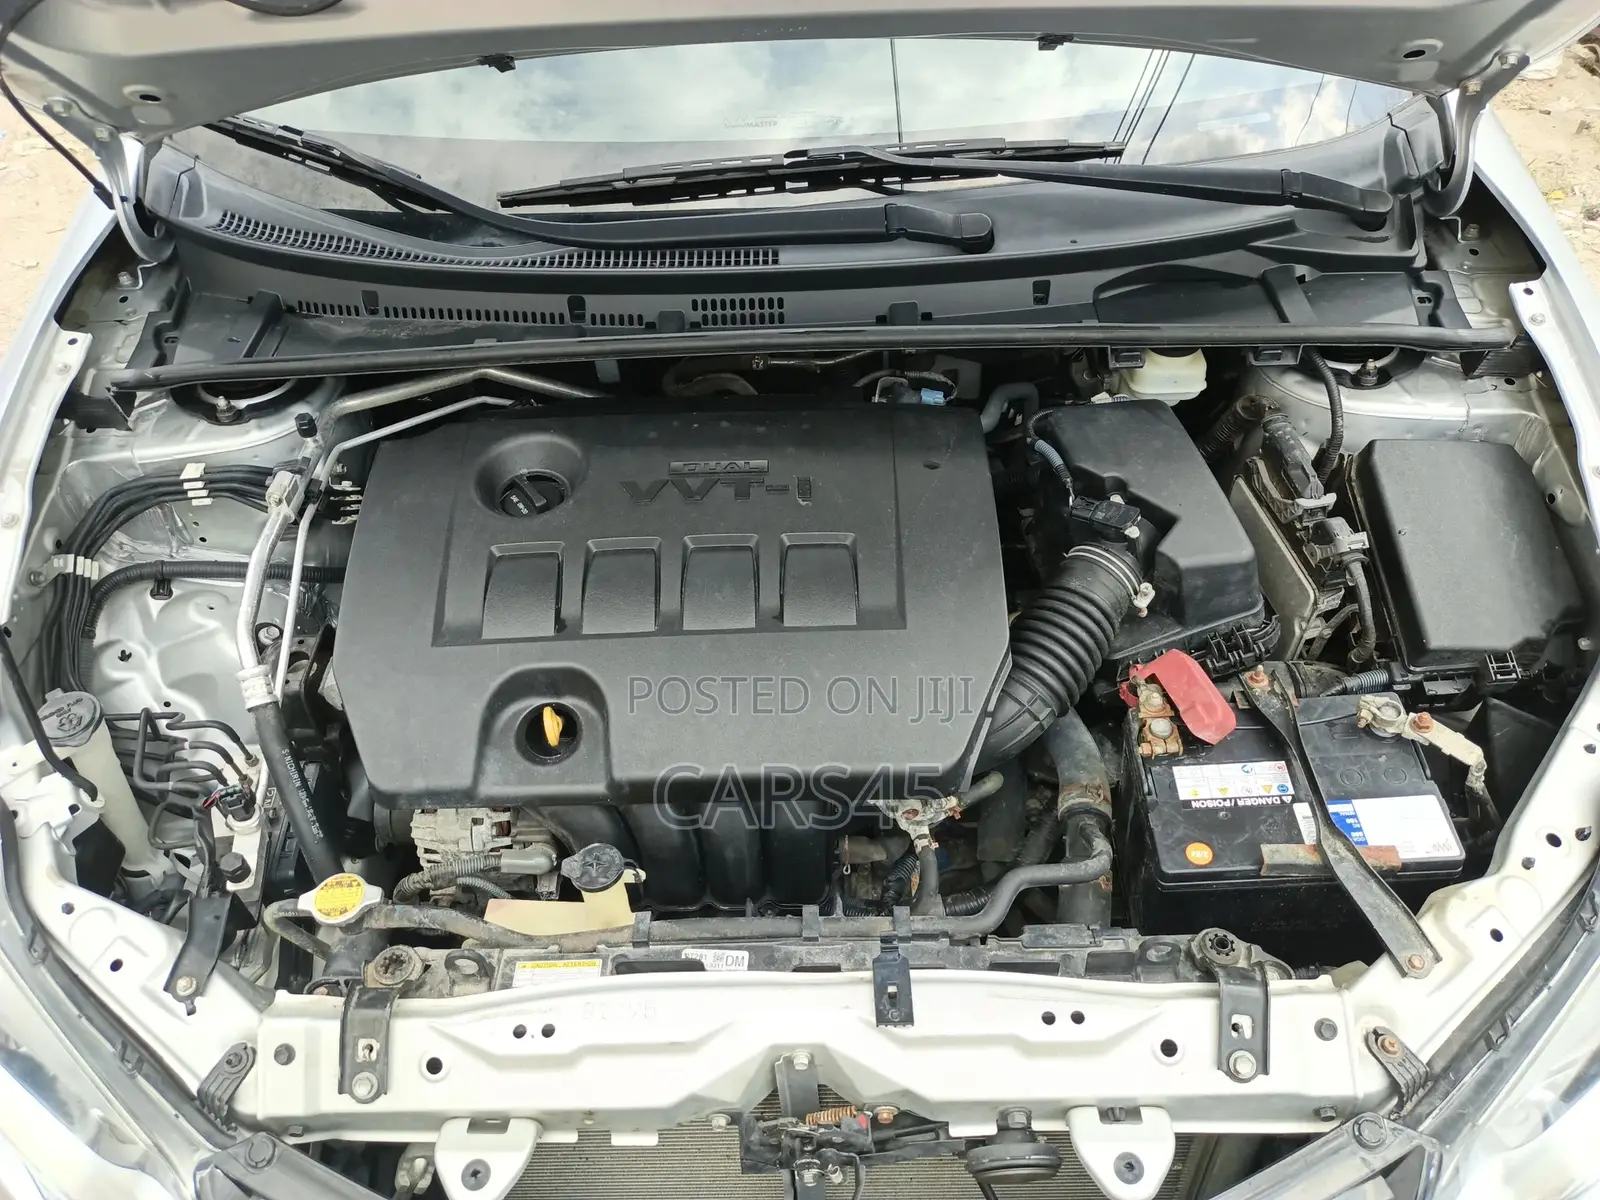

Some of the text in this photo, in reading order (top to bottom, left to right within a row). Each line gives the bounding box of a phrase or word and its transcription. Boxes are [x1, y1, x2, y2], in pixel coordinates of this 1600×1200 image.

[682, 460, 759, 472] DUAL
[1191, 799, 1231, 809] POISON
[1237, 796, 1281, 807] DANGER
[725, 954, 745, 968] DM
